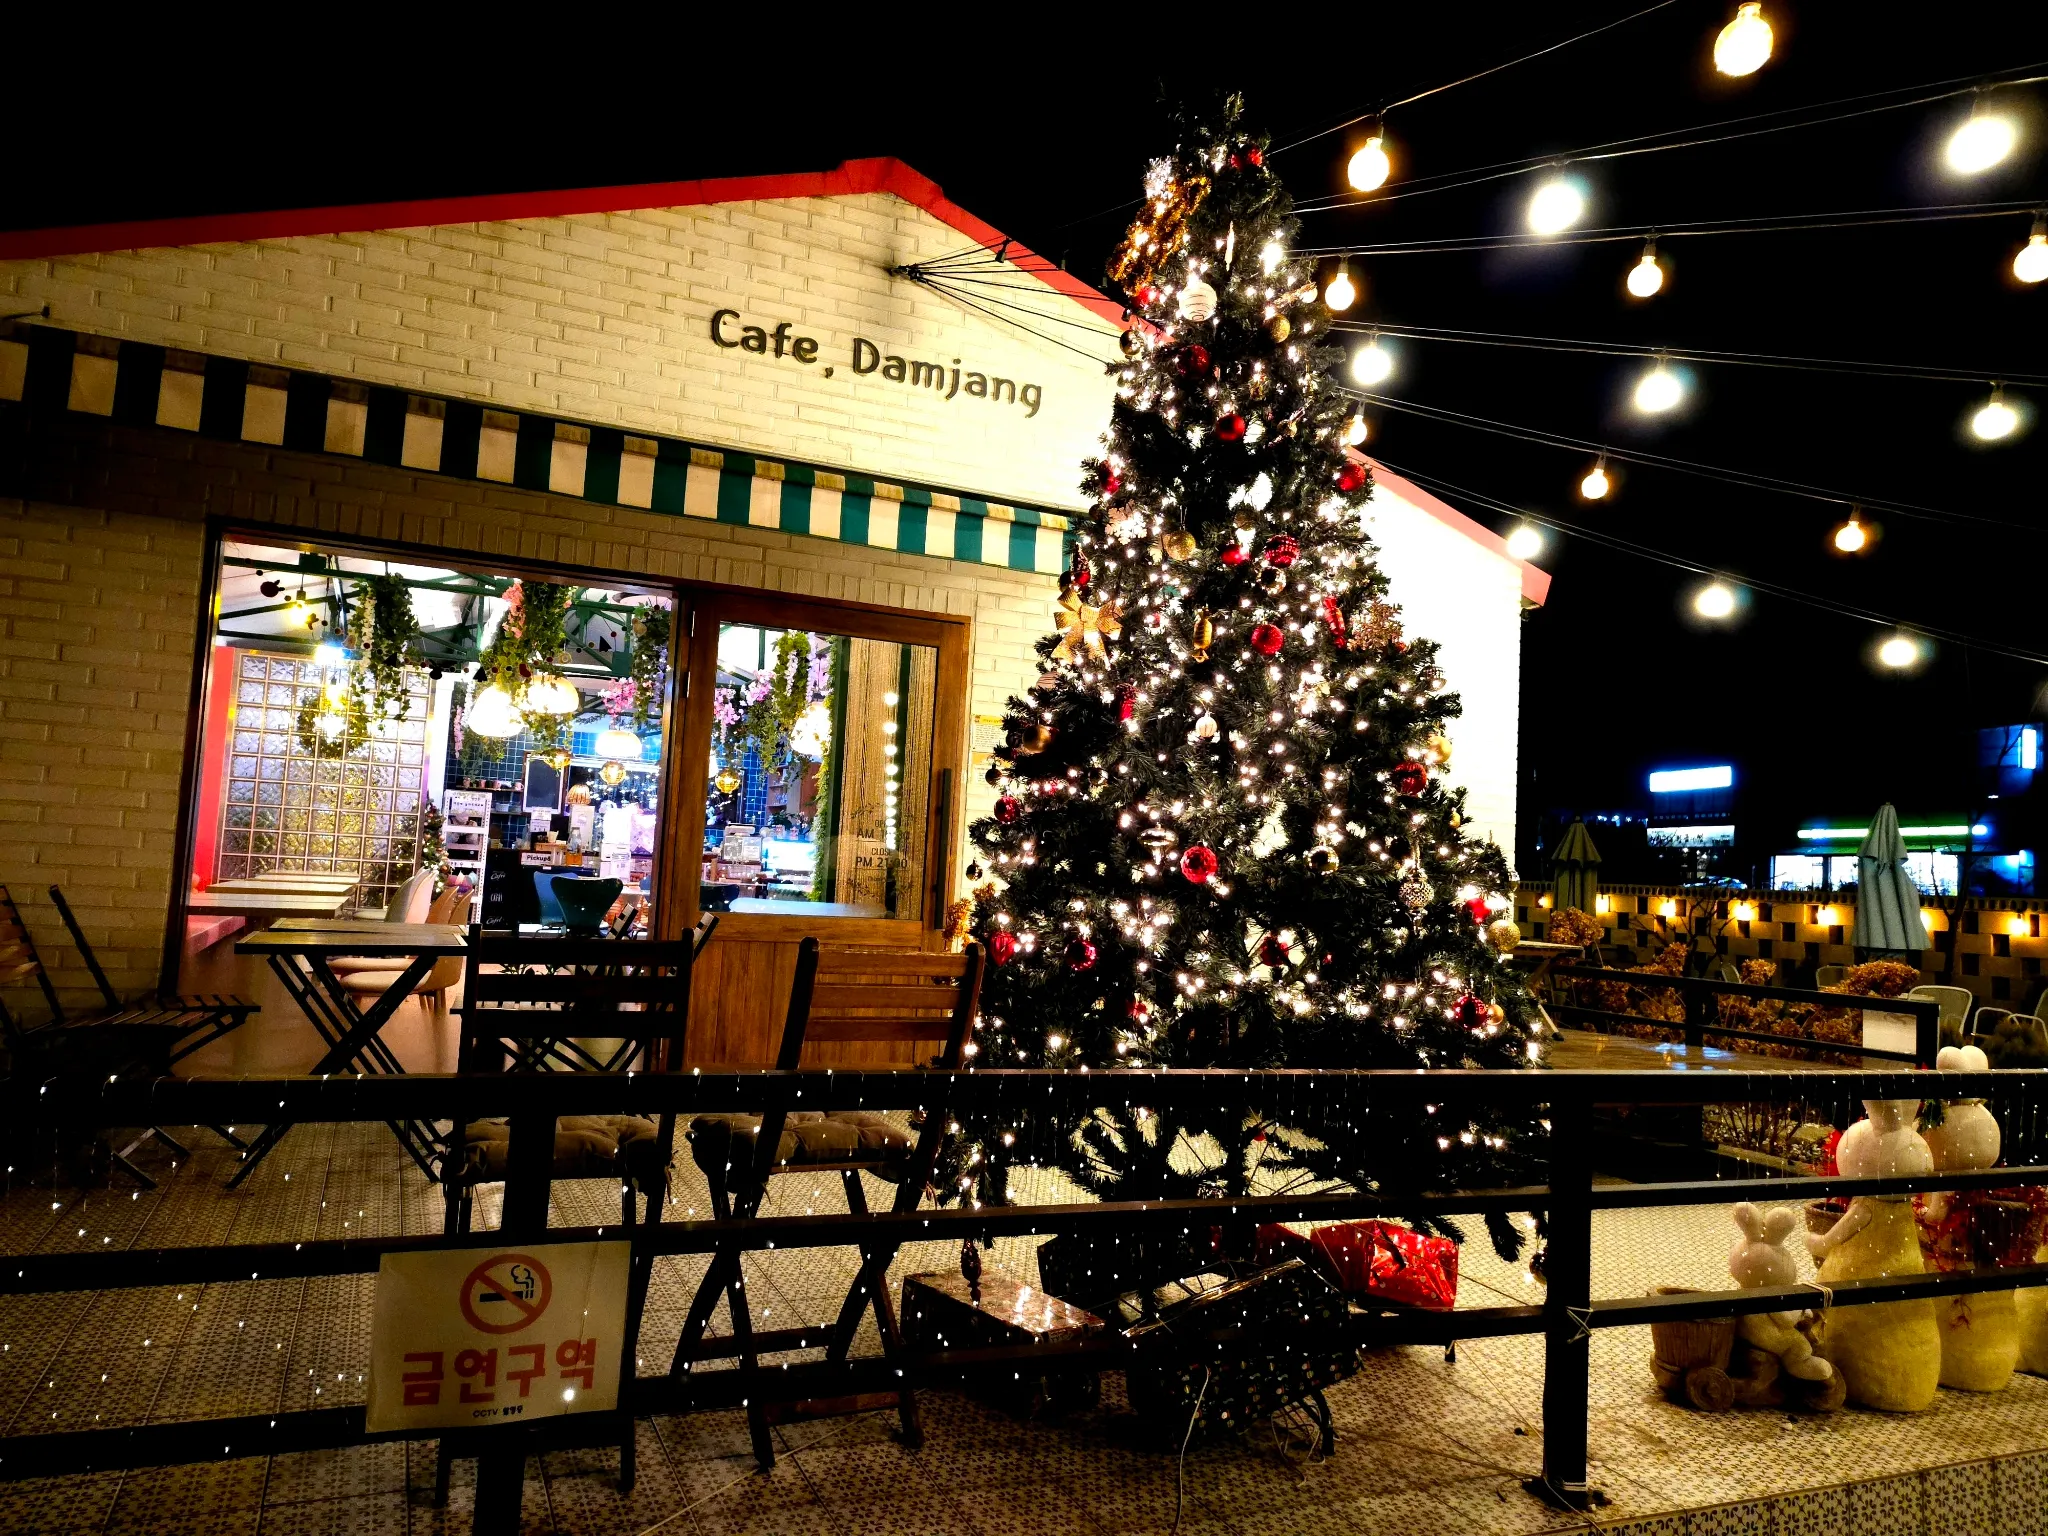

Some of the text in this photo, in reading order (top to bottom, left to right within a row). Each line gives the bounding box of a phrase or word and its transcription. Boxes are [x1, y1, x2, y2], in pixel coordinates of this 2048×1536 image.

[852, 337, 1042, 418] Damjang
[856, 828, 874, 839] AM
[856, 857, 872, 868] PM
[401, 1338, 597, 1405] 금연구역
[472, 1408, 499, 1418] CCTV
